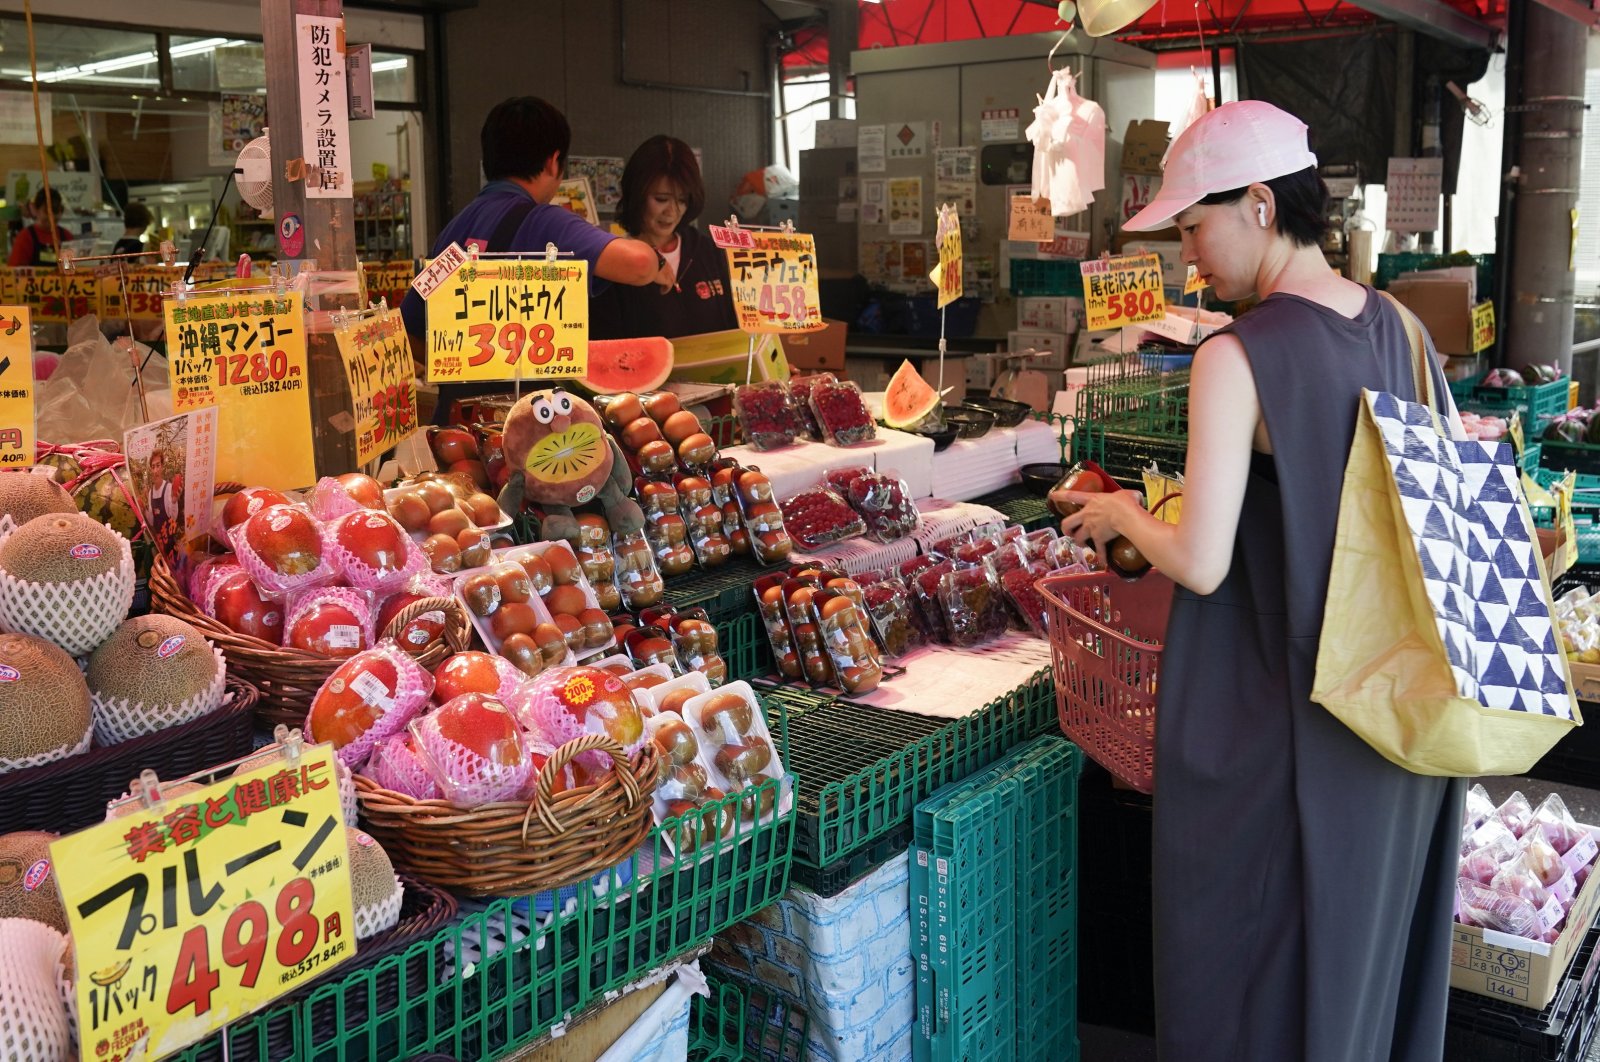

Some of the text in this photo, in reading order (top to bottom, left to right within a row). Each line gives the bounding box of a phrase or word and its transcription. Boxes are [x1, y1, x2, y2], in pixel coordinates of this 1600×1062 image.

[311, 24, 338, 191] 防犯カメラ設置店
[733, 252, 813, 284] デラウェア
[1090, 269, 1160, 298] 尾花沢スイカ
[455, 284, 566, 321] ゴールドキウイ
[759, 284, 819, 323] 458円
[1107, 290, 1163, 321] 580円
[178, 317, 293, 358] 沖縄マンゴー
[433, 322, 574, 368] 1パック 398円
[175, 350, 301, 387] 1パック 1280円
[433, 367, 463, 377] アキダイ
[176, 396, 215, 407] アキダイ
[123, 759, 330, 863] 美容と健康に
[76, 809, 338, 951] プルーン
[938, 886, 947, 928] S.C.R.
[919, 907, 928, 946] S.C.R.
[939, 934, 947, 953] 619
[88, 876, 342, 1032] 1パック 498円
[277, 939, 347, 986] (税込537.84円)
[920, 953, 929, 972] 619
[1474, 948, 1481, 958] 2
[1486, 951, 1493, 960] 3
[1508, 956, 1515, 966] 5
[1519, 959, 1526, 969] 6
[1491, 982, 1515, 998] 144
